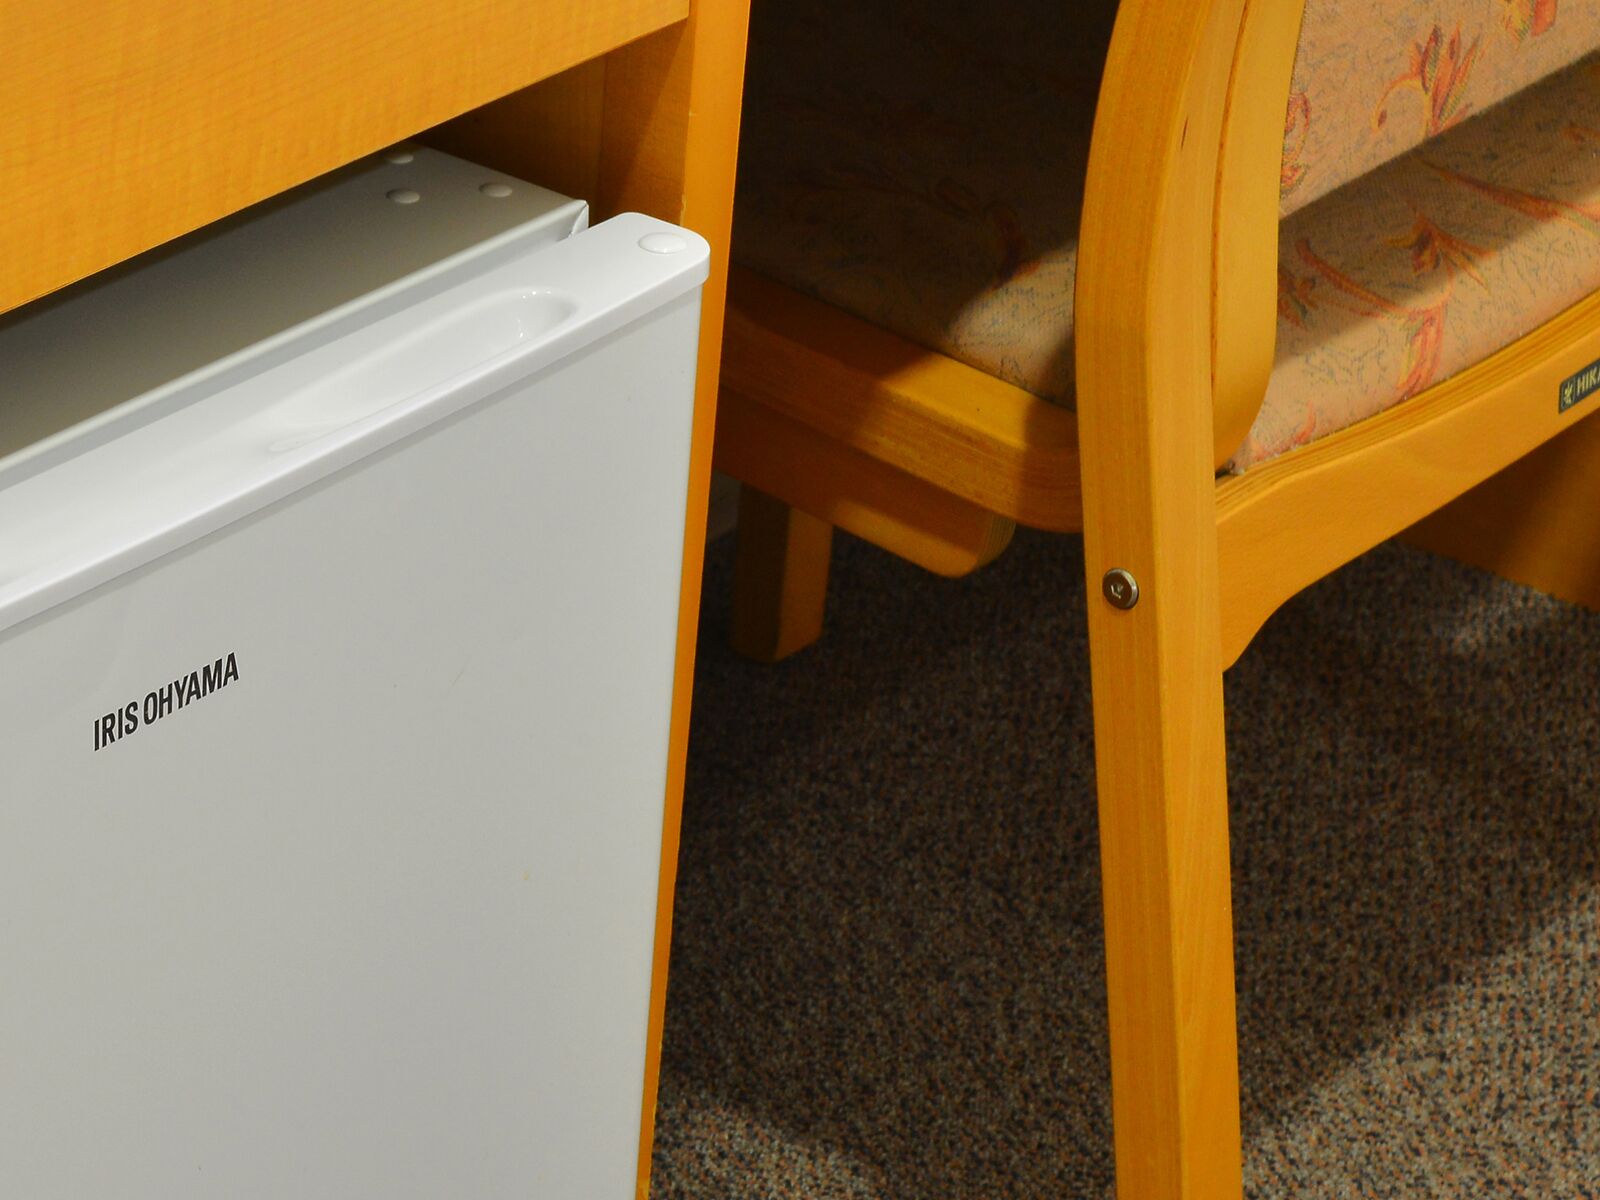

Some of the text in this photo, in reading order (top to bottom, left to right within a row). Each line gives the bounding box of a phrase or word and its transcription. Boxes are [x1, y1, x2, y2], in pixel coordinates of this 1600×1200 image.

[1576, 365, 1600, 396] HIK
[94, 652, 239, 751] IRIS OHYAMA
